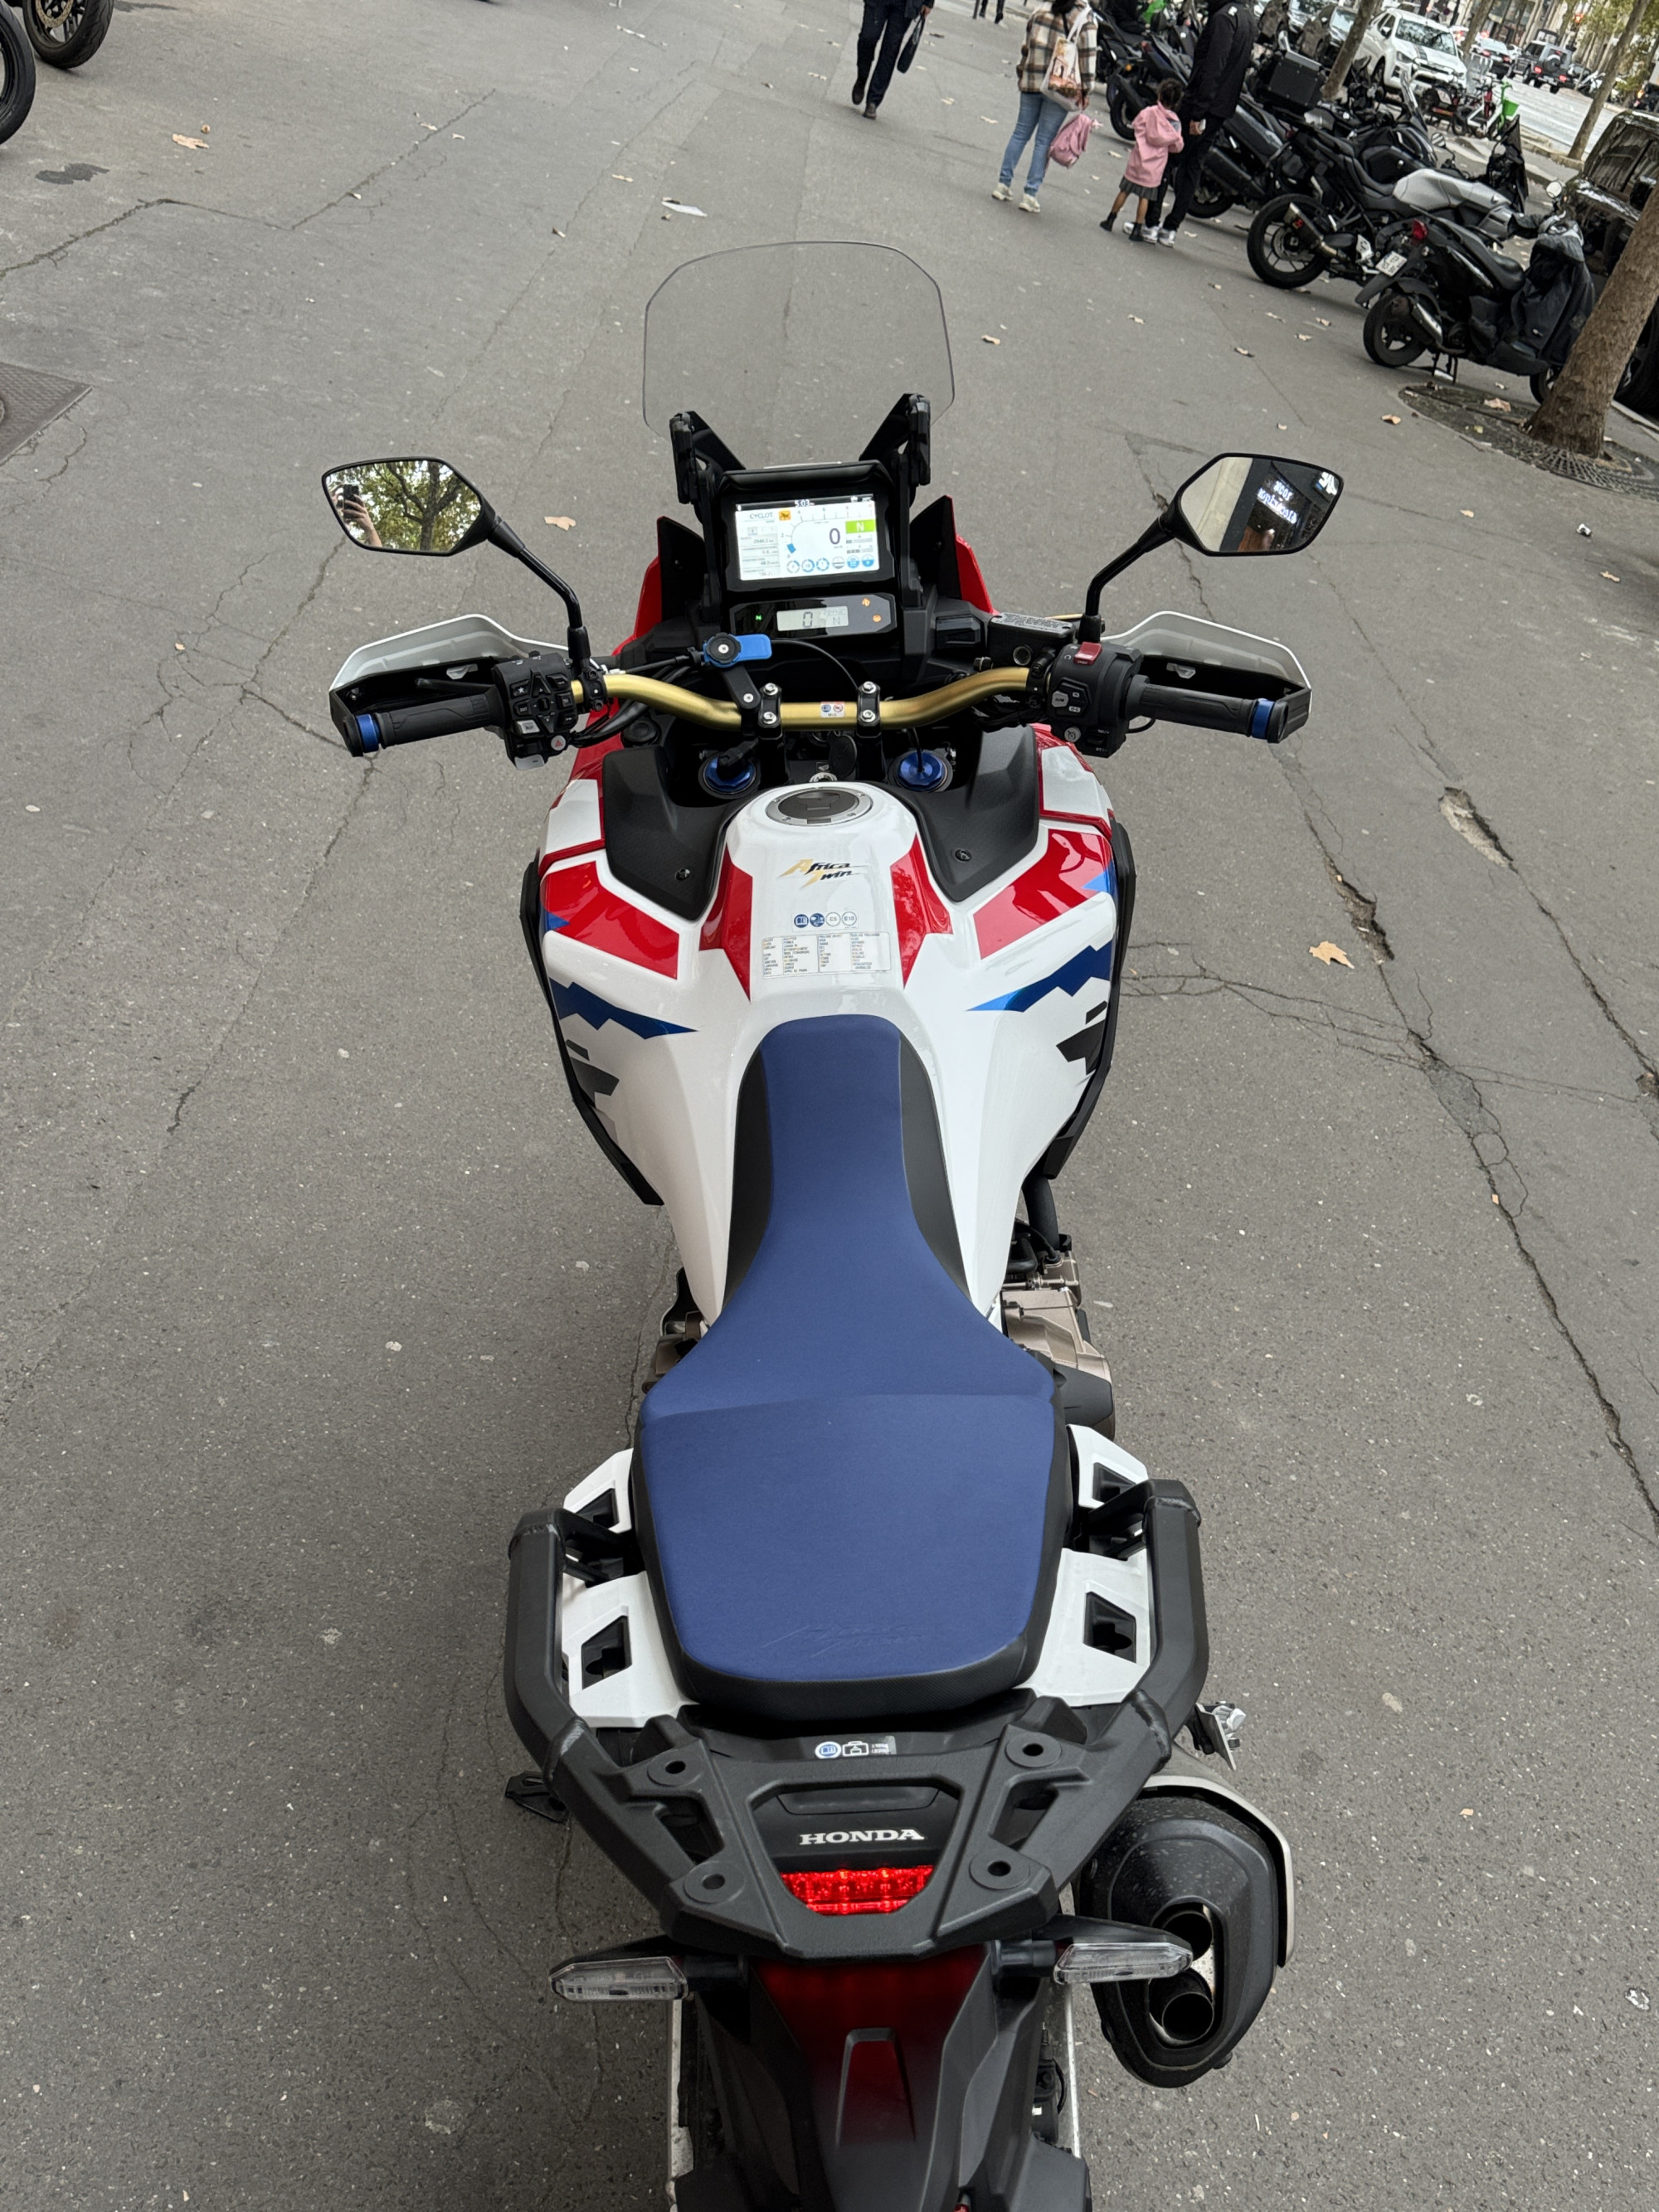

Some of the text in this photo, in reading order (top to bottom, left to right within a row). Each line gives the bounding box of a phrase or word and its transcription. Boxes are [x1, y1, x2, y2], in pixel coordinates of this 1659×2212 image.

[829, 527, 841, 545] 0
[856, 523, 864, 532] N
[802, 611, 813, 628] 0
[779, 858, 851, 878] Africa
[799, 868, 853, 891] Twin
[799, 1828, 925, 1845] HONDA
